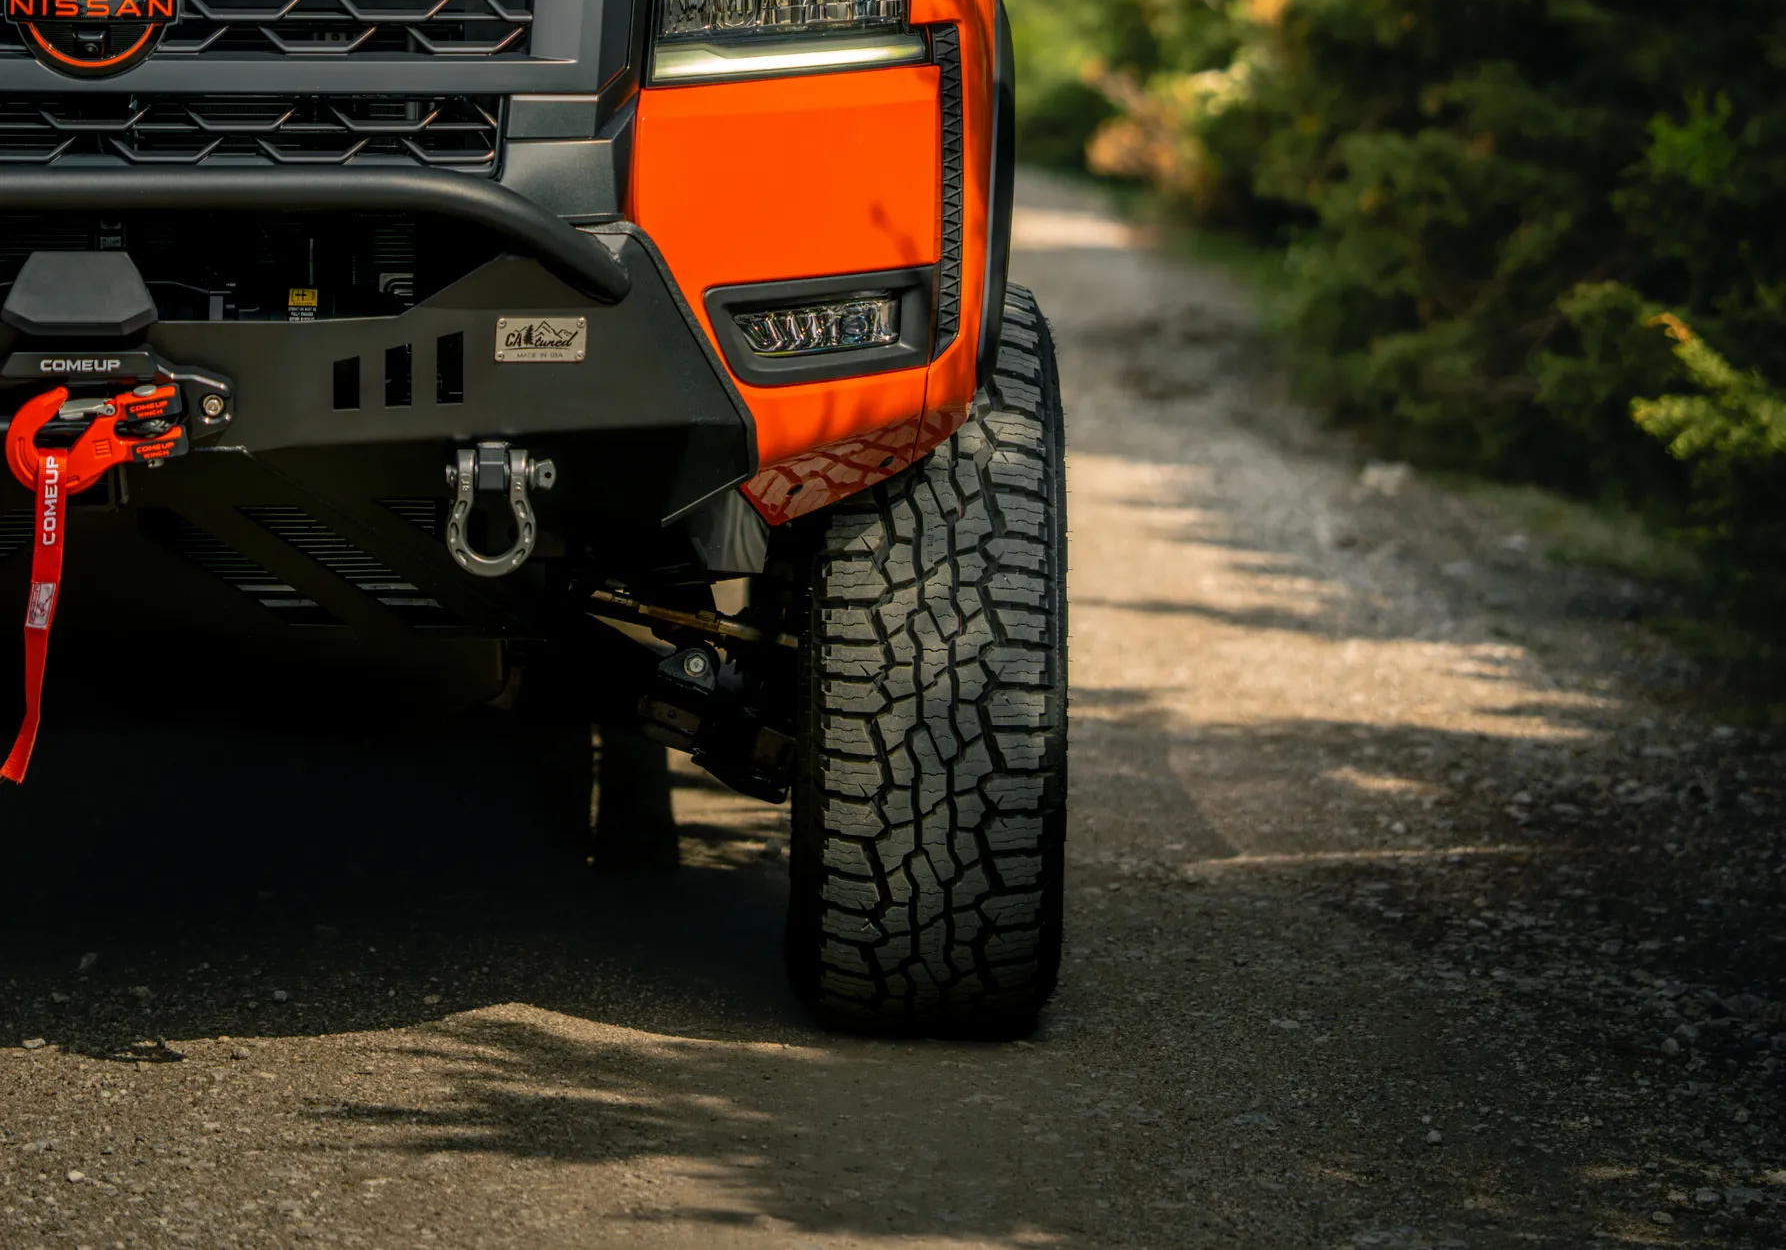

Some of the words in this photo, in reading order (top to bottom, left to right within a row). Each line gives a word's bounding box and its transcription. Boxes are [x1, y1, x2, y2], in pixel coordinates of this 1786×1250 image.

[534, 330, 579, 347] tuned
[40, 359, 121, 372] COMEUP
[129, 400, 168, 413] COMEUP
[136, 408, 163, 419] WINCH
[136, 441, 175, 454] COMEUP
[142, 449, 170, 459] WINCH
[42, 455, 59, 546] COMEUP
